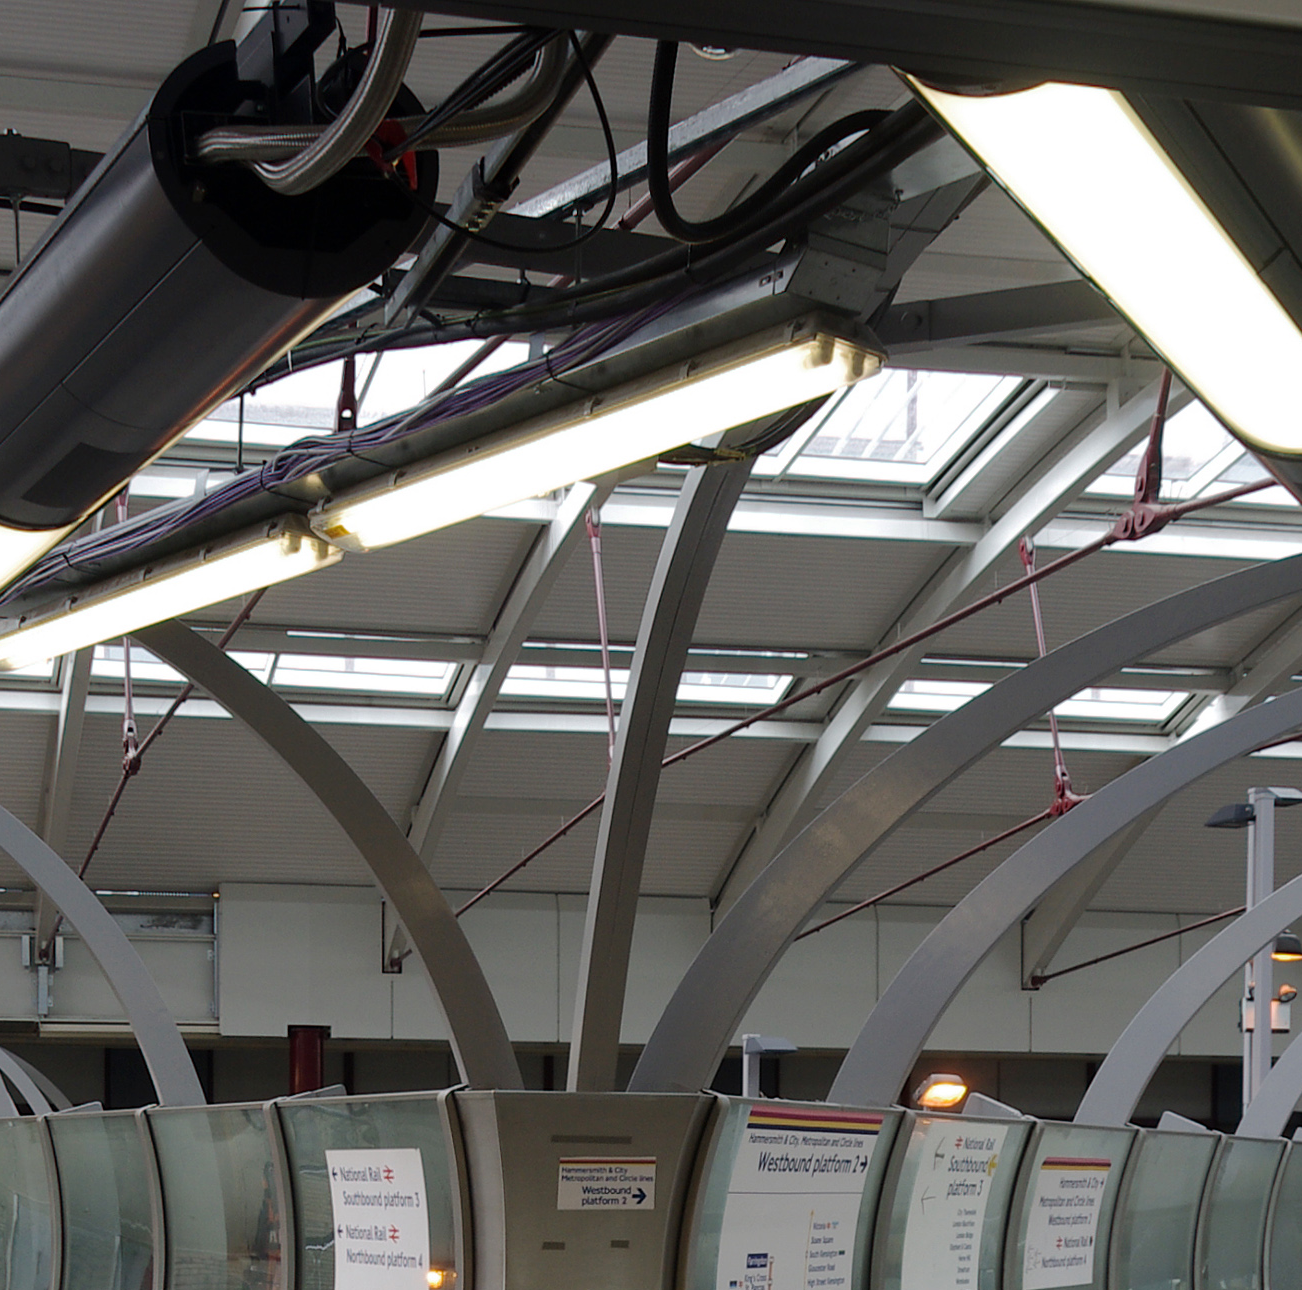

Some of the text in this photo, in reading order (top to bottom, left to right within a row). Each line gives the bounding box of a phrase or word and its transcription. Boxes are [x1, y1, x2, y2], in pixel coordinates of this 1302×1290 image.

[749, 1133, 783, 1144] Hammersmith
[801, 1136, 831, 1148] Metropolitan
[561, 1166, 608, 1174] Hammersmith
[614, 1166, 628, 1176] City
[758, 1151, 860, 1178] Westbound platform 2
[948, 1154, 991, 1173] Southbound
[340, 1166, 383, 1182] National Rail
[561, 1175, 604, 1183] Metropolitan
[582, 1185, 632, 1195] Westbound
[946, 1178, 977, 1200] platform
[342, 1190, 420, 1210] Southbound platform 3
[581, 1196, 628, 1207] platform 2
[345, 1224, 387, 1241] National Rail
[346, 1248, 423, 1271] Northbound platform 4
